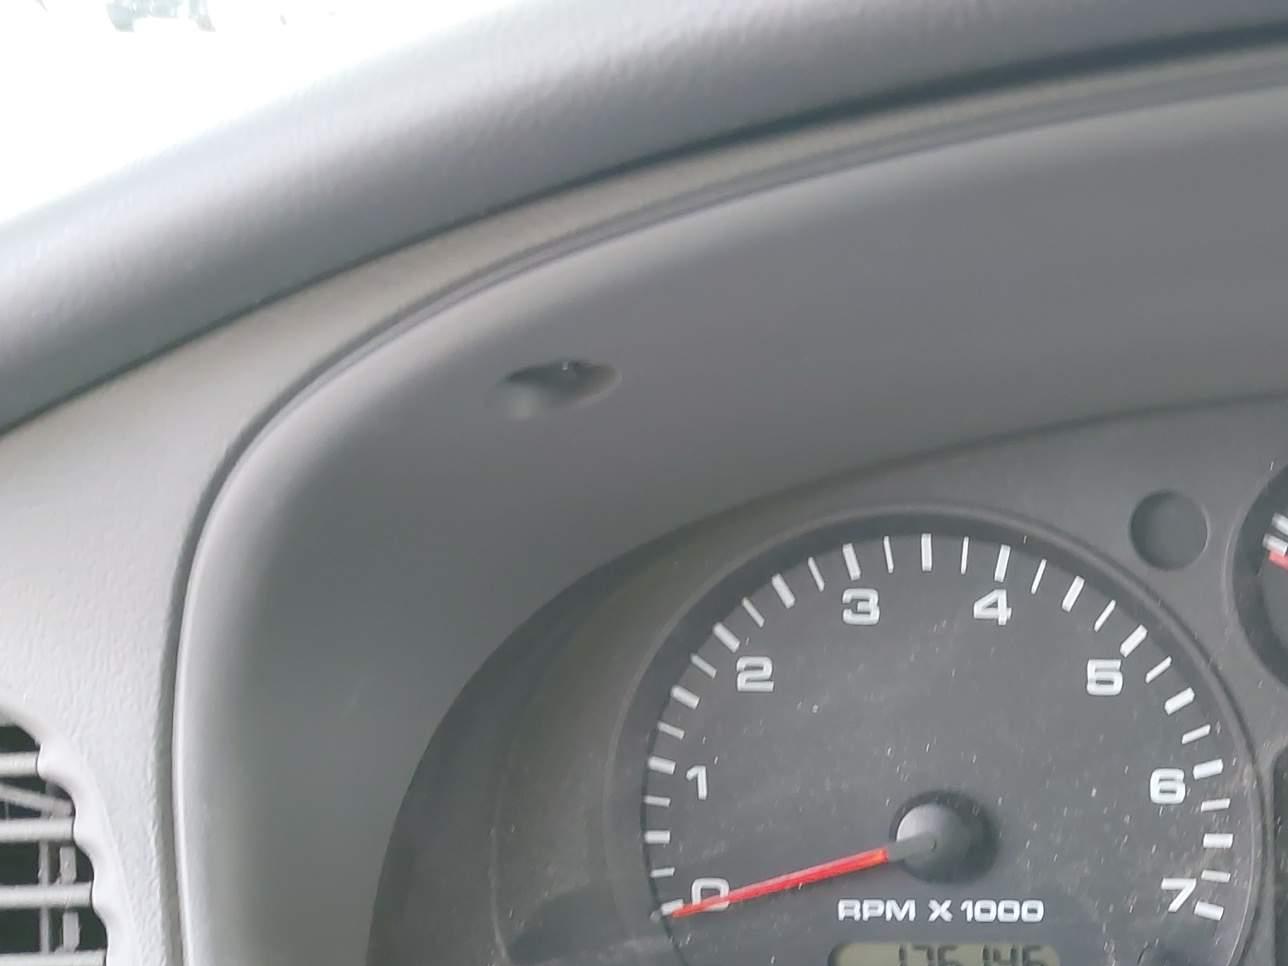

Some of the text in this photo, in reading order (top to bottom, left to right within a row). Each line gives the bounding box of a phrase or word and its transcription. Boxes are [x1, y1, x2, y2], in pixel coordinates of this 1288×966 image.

[841, 588, 881, 626] 3
[973, 588, 1012, 626] 4
[736, 656, 775, 692] 2
[1085, 659, 1123, 696] 5
[686, 766, 709, 800] 1
[1149, 768, 1186, 804] 6
[691, 878, 731, 912] 0
[838, 900, 1045, 922] RPM X 1000
[1160, 878, 1197, 912] 7
